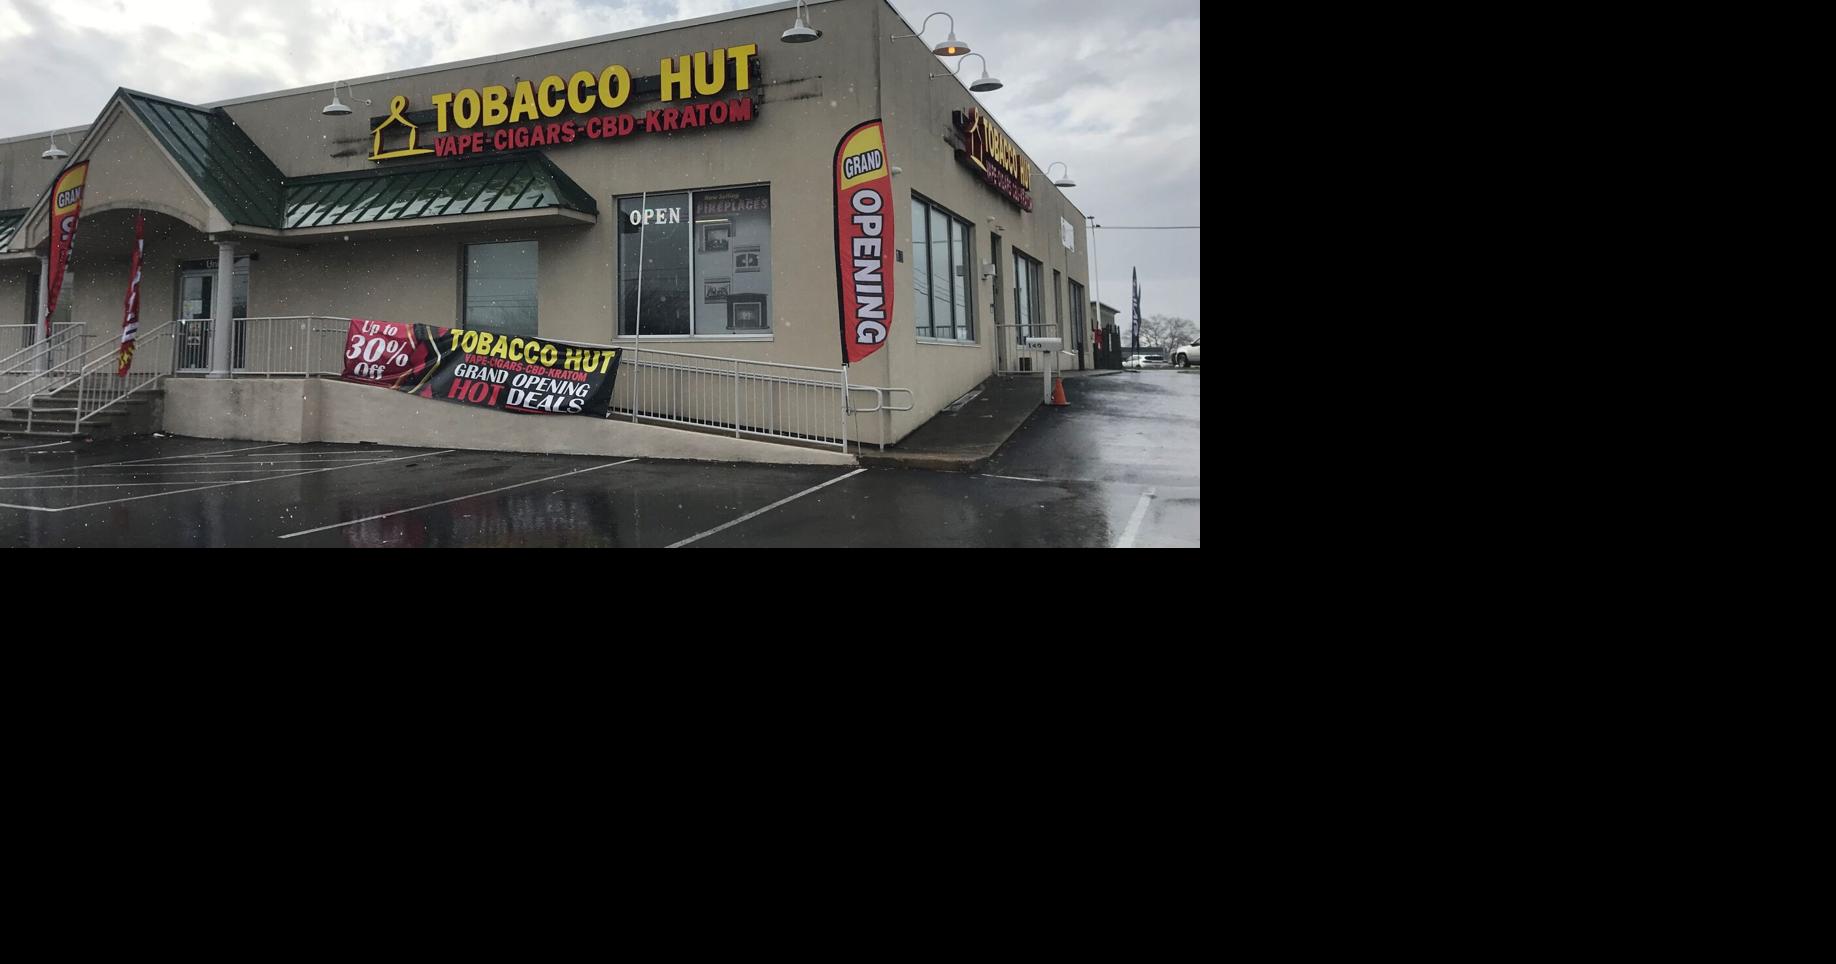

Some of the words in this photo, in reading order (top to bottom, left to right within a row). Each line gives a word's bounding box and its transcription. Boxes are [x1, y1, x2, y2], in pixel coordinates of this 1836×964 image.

[431, 64, 631, 133] TOBACCO
[660, 43, 756, 102] HUT
[432, 98, 752, 158] VAPE-CIGARS-CBD-KRATOM
[845, 150, 882, 179] GRAND
[983, 117, 1018, 180] TOBACCO
[58, 187, 81, 209] GRAN
[697, 198, 768, 214] FIREPLACES
[629, 207, 681, 226] OPEN
[851, 188, 887, 345] OPENING
[362, 320, 380, 336] Up
[383, 324, 398, 336] to
[346, 334, 409, 367] 30%
[450, 328, 558, 367] TOBACCO
[563, 347, 615, 375] HUT
[353, 362, 386, 380] Off
[454, 363, 509, 384] GRAND
[512, 373, 591, 398] OPENING
[447, 378, 505, 407] HOT
[506, 388, 585, 415] DEALS
